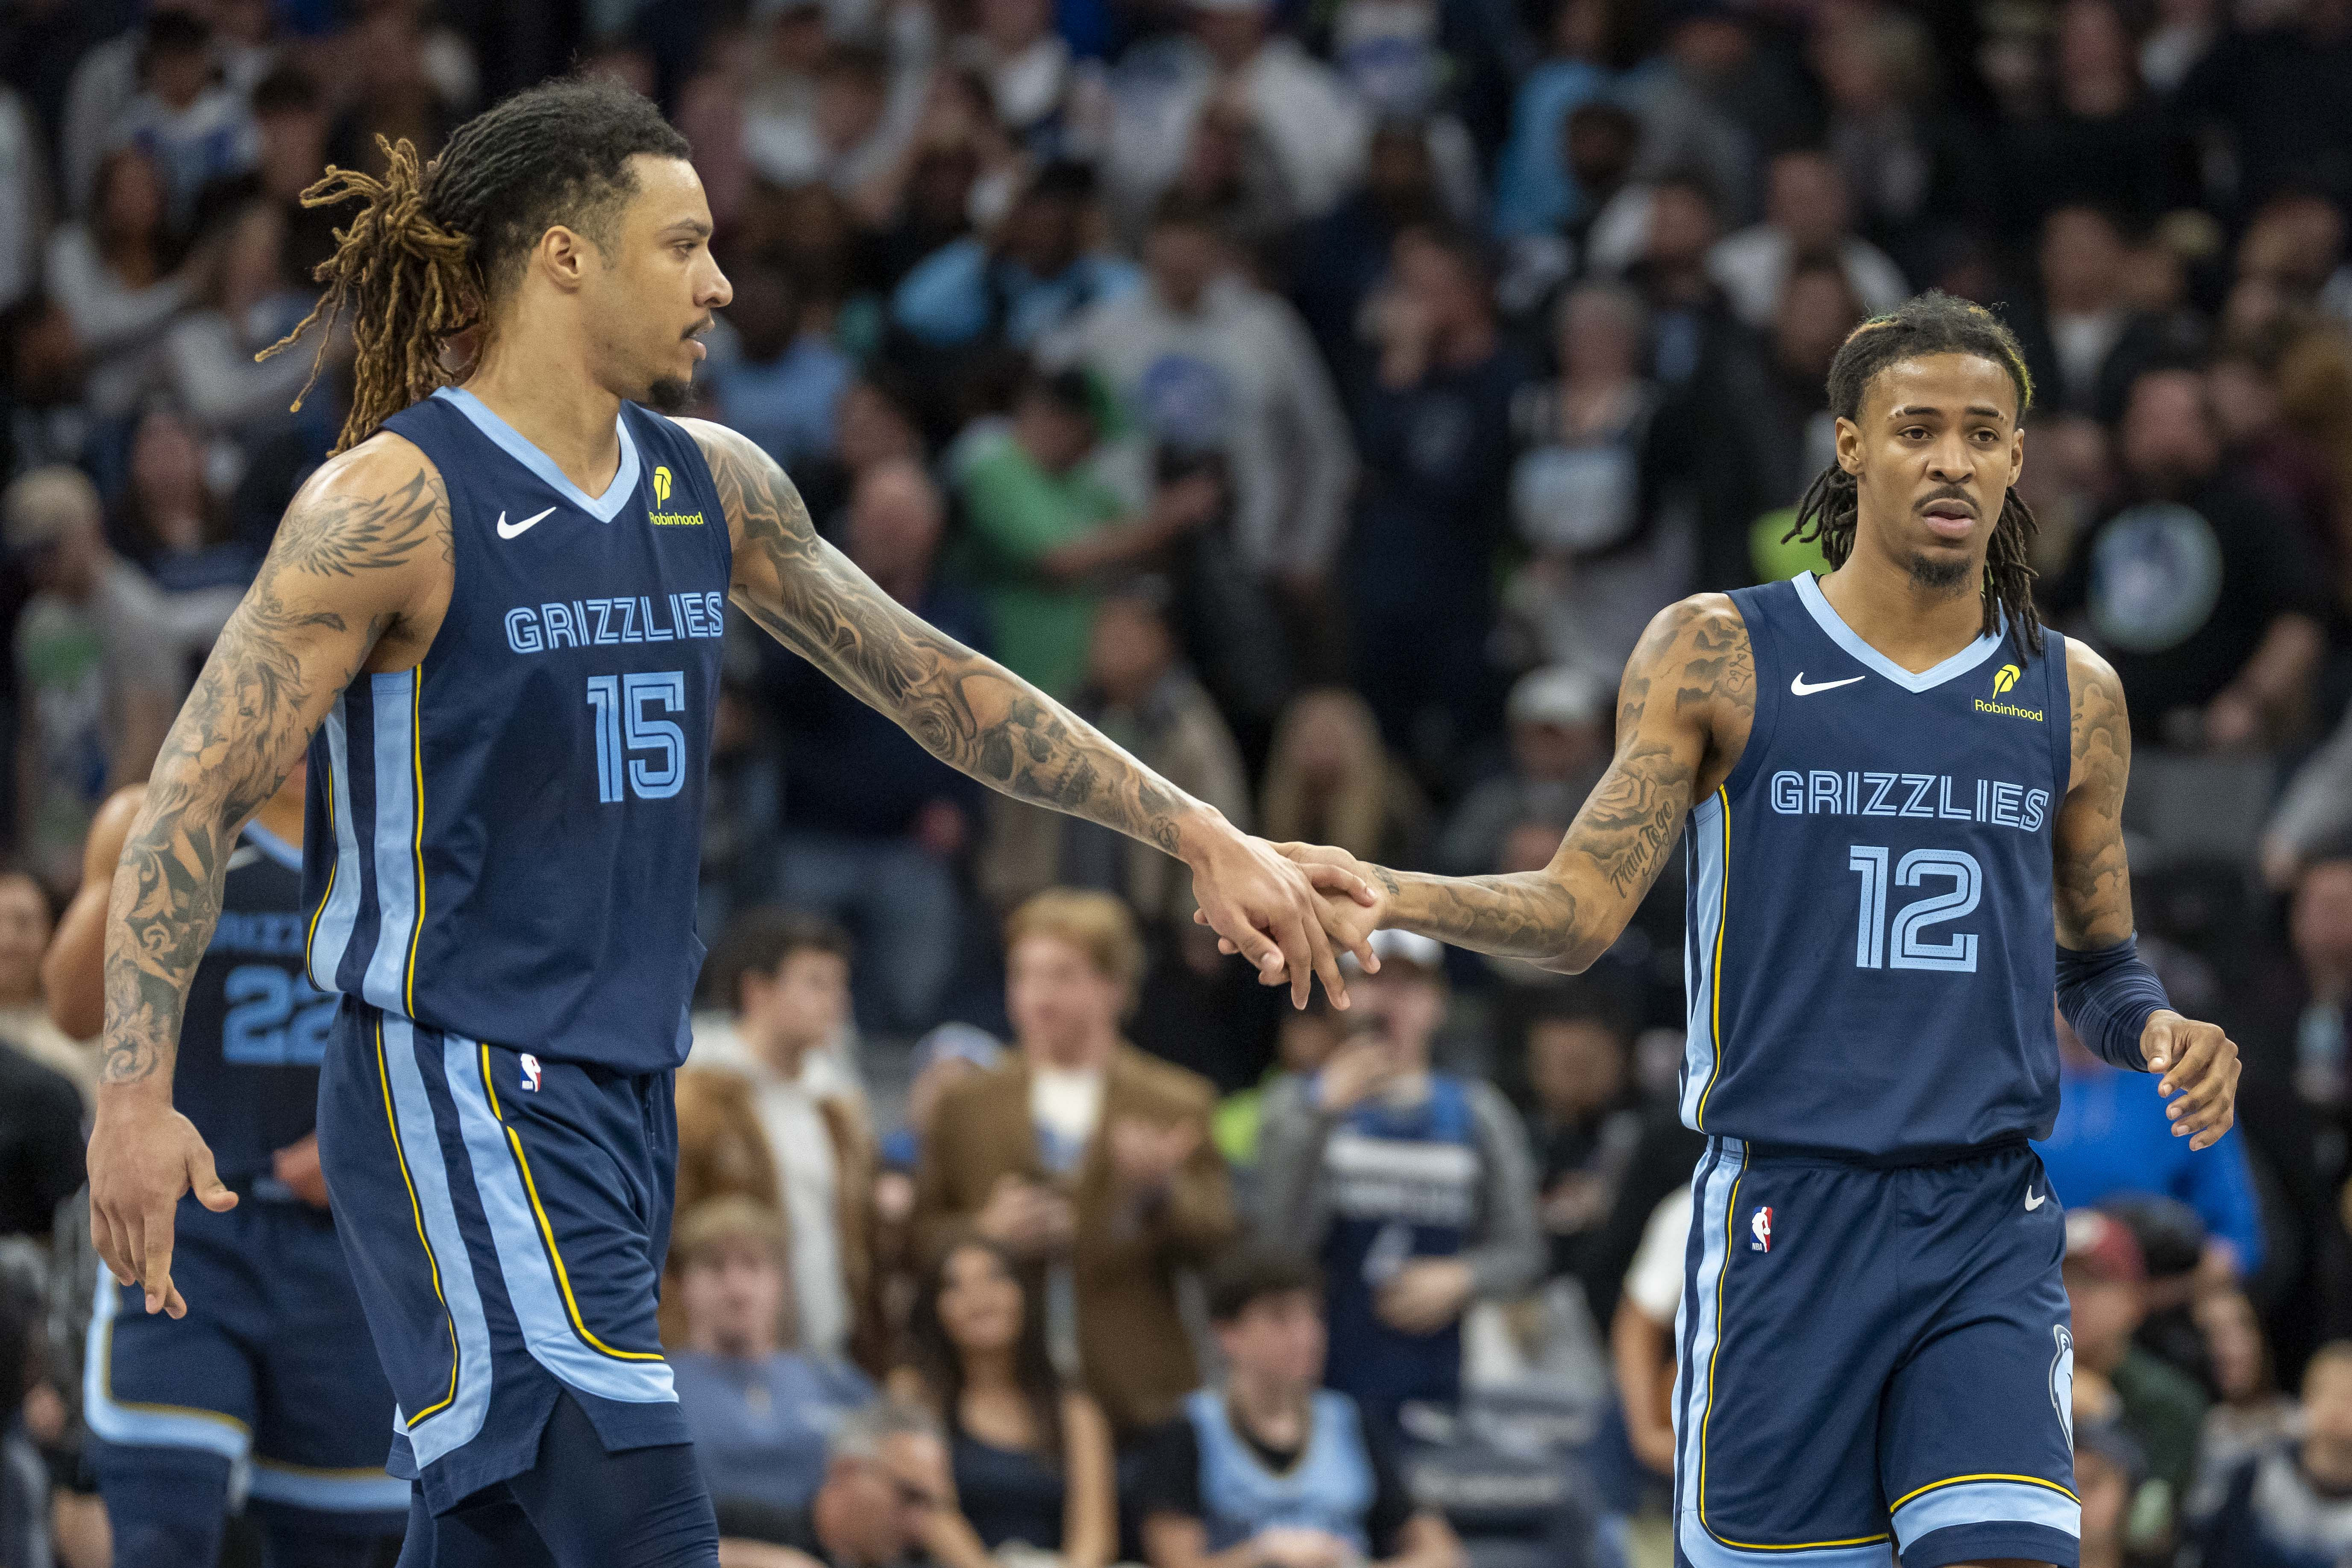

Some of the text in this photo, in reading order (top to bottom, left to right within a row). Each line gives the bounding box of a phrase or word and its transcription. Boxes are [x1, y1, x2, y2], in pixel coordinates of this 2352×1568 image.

[649, 511, 704, 526] Robinhood
[505, 591, 723, 655] GRIZZLIES
[587, 670, 686, 803] 15
[1975, 699, 2043, 722] Robinhood
[1771, 770, 2049, 832] GRIZZLIES
[1849, 845, 1982, 973] 12
[223, 964, 342, 1064] 22
